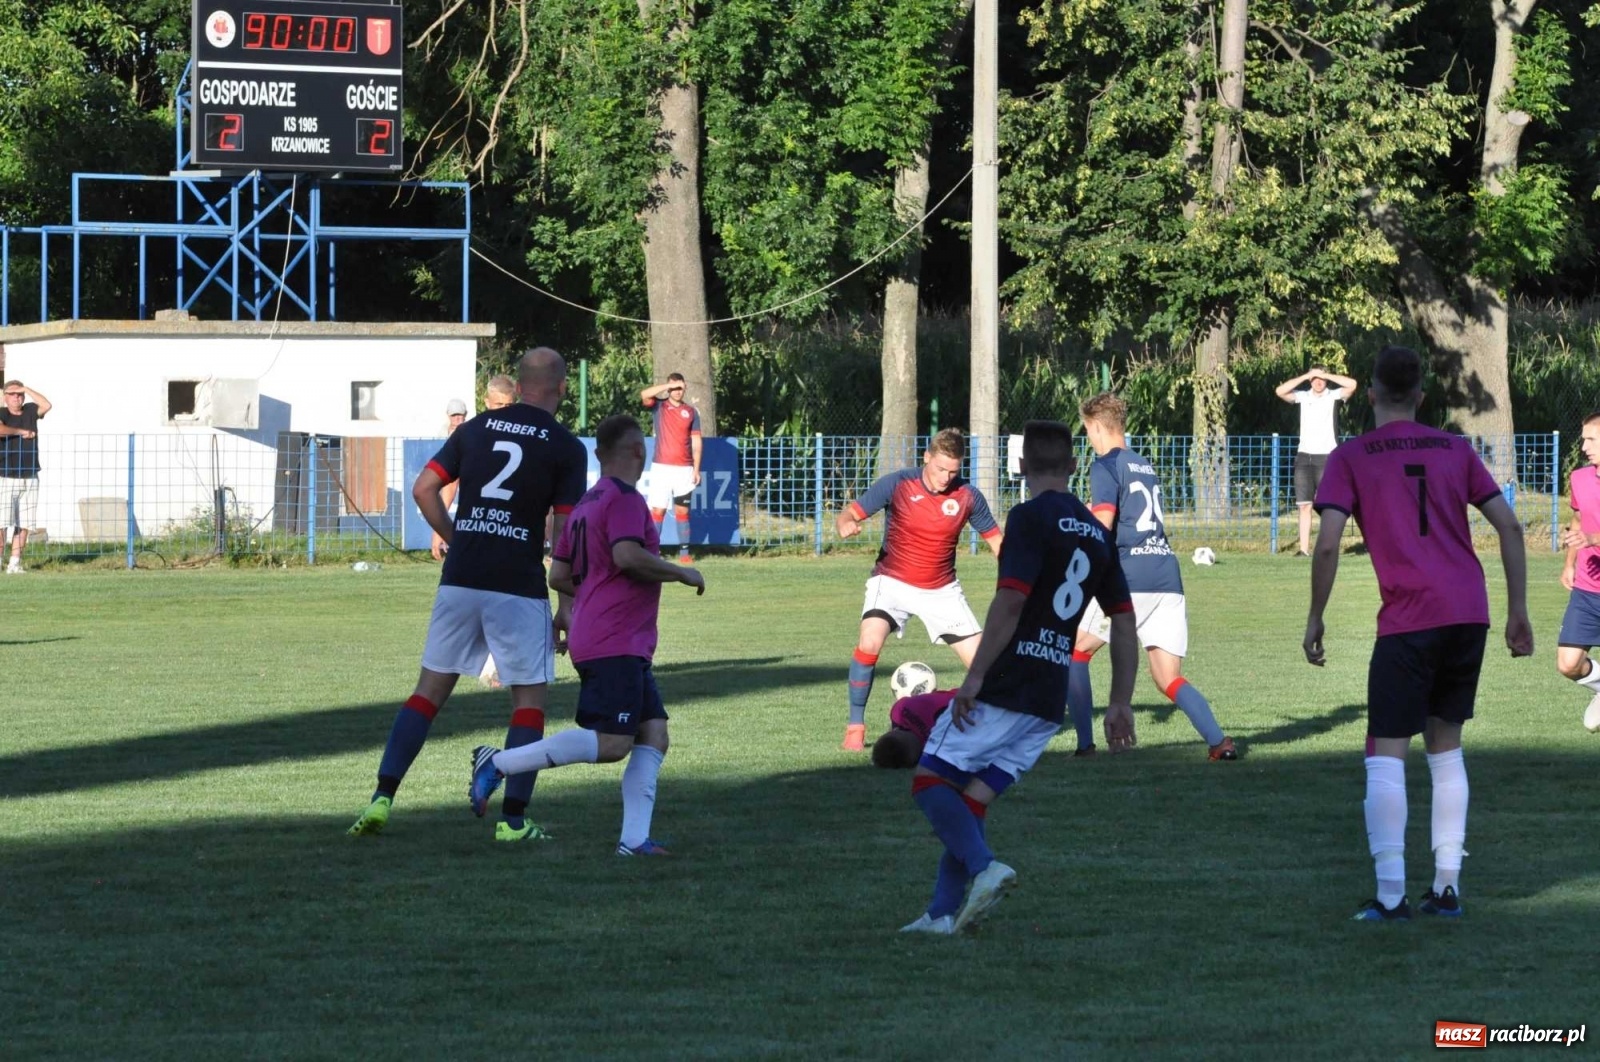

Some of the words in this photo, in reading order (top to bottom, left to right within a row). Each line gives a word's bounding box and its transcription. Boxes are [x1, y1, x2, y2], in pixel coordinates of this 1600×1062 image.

[246, 14, 354, 52] 90:00
[200, 79, 296, 107] GOSPODARZE
[346, 79, 398, 110] GOŚCIE
[219, 114, 241, 149] 2
[284, 116, 297, 132] KS
[299, 117, 318, 132] 1905
[369, 119, 390, 154] 2
[271, 137, 330, 153] KRZANOWICE
[485, 418, 536, 437] HERBER
[538, 428, 550, 441] S.
[480, 440, 523, 500] 2
[471, 506, 484, 519] KS
[486, 508, 512, 523] 1905
[455, 519, 529, 541] KRZANOWICE
[1052, 547, 1091, 621] 8
[1039, 627, 1055, 645] KS
